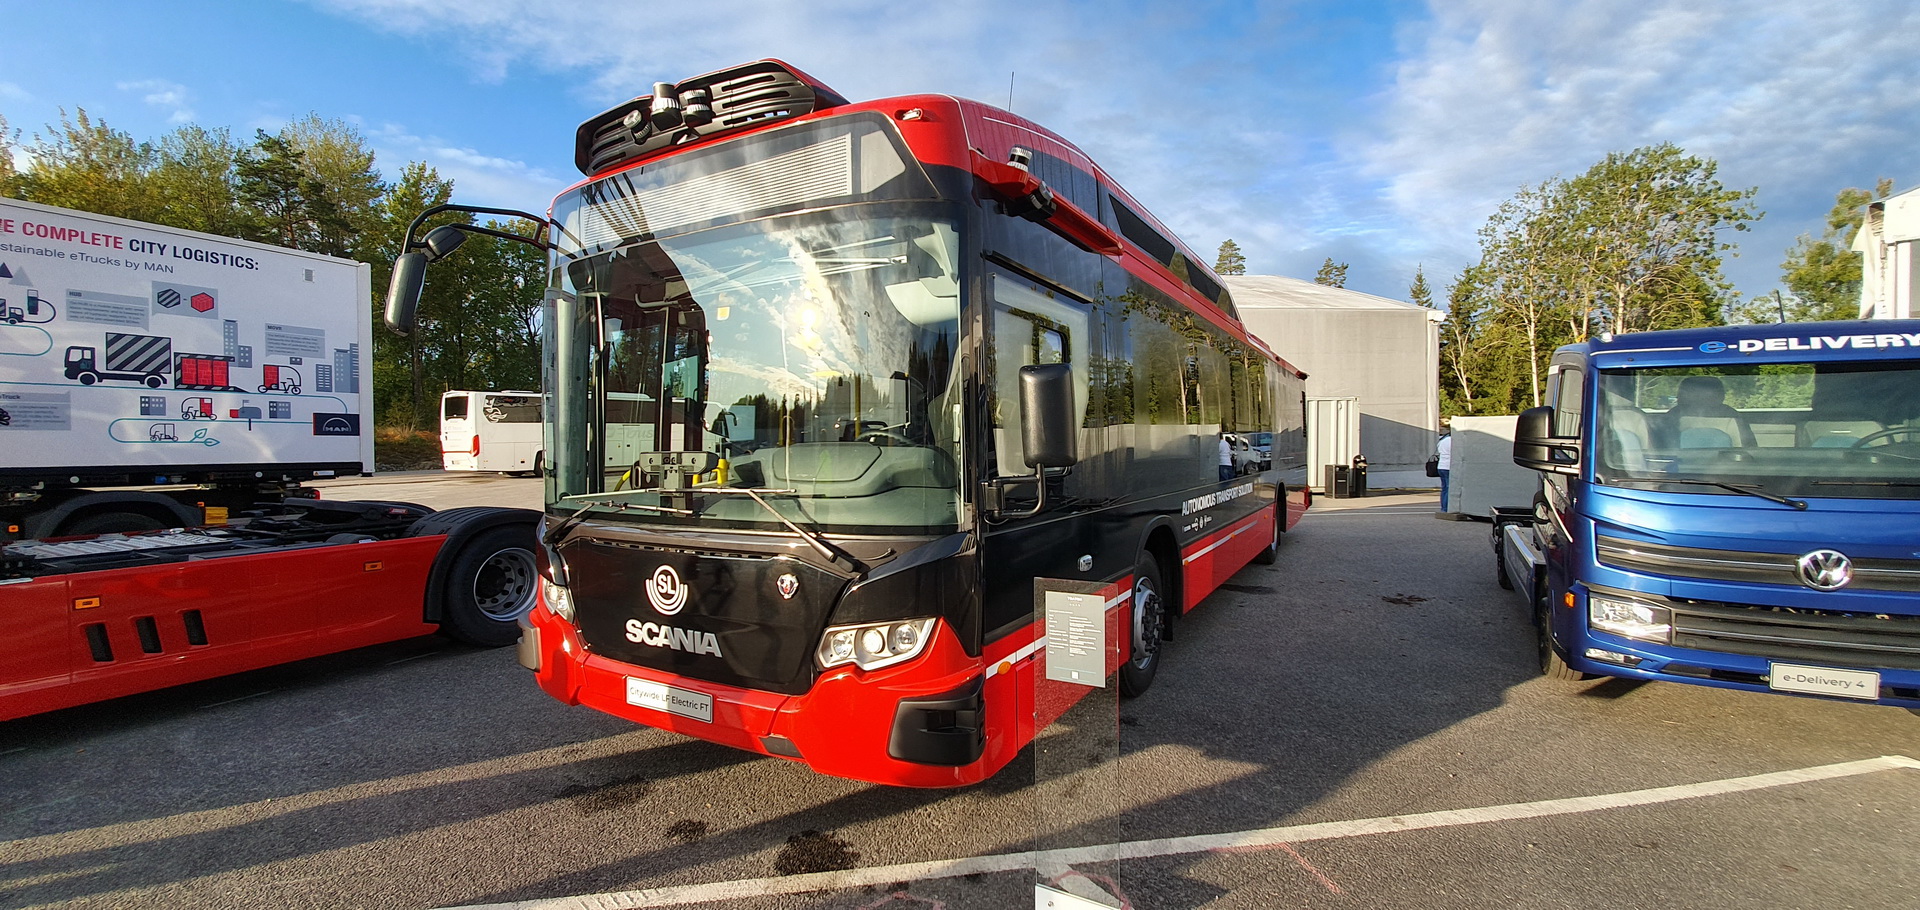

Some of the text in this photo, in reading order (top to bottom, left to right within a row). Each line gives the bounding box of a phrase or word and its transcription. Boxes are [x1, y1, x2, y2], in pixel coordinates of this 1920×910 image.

[0, 218, 259, 270] E COMPLETE CITY LOGISTICS:
[0, 242, 174, 274] stainable eTrucks by MAN
[1699, 333, 1920, 353] e-DELIVERY
[1182, 482, 1253, 516] AUTONOMOUS TRANSPORT SOLUTION
[657, 574, 676, 595] SL
[625, 618, 723, 658] SCANIA
[1783, 674, 1865, 689] e-Delivery 4
[629, 686, 709, 713] Citywide LF Electric FT
